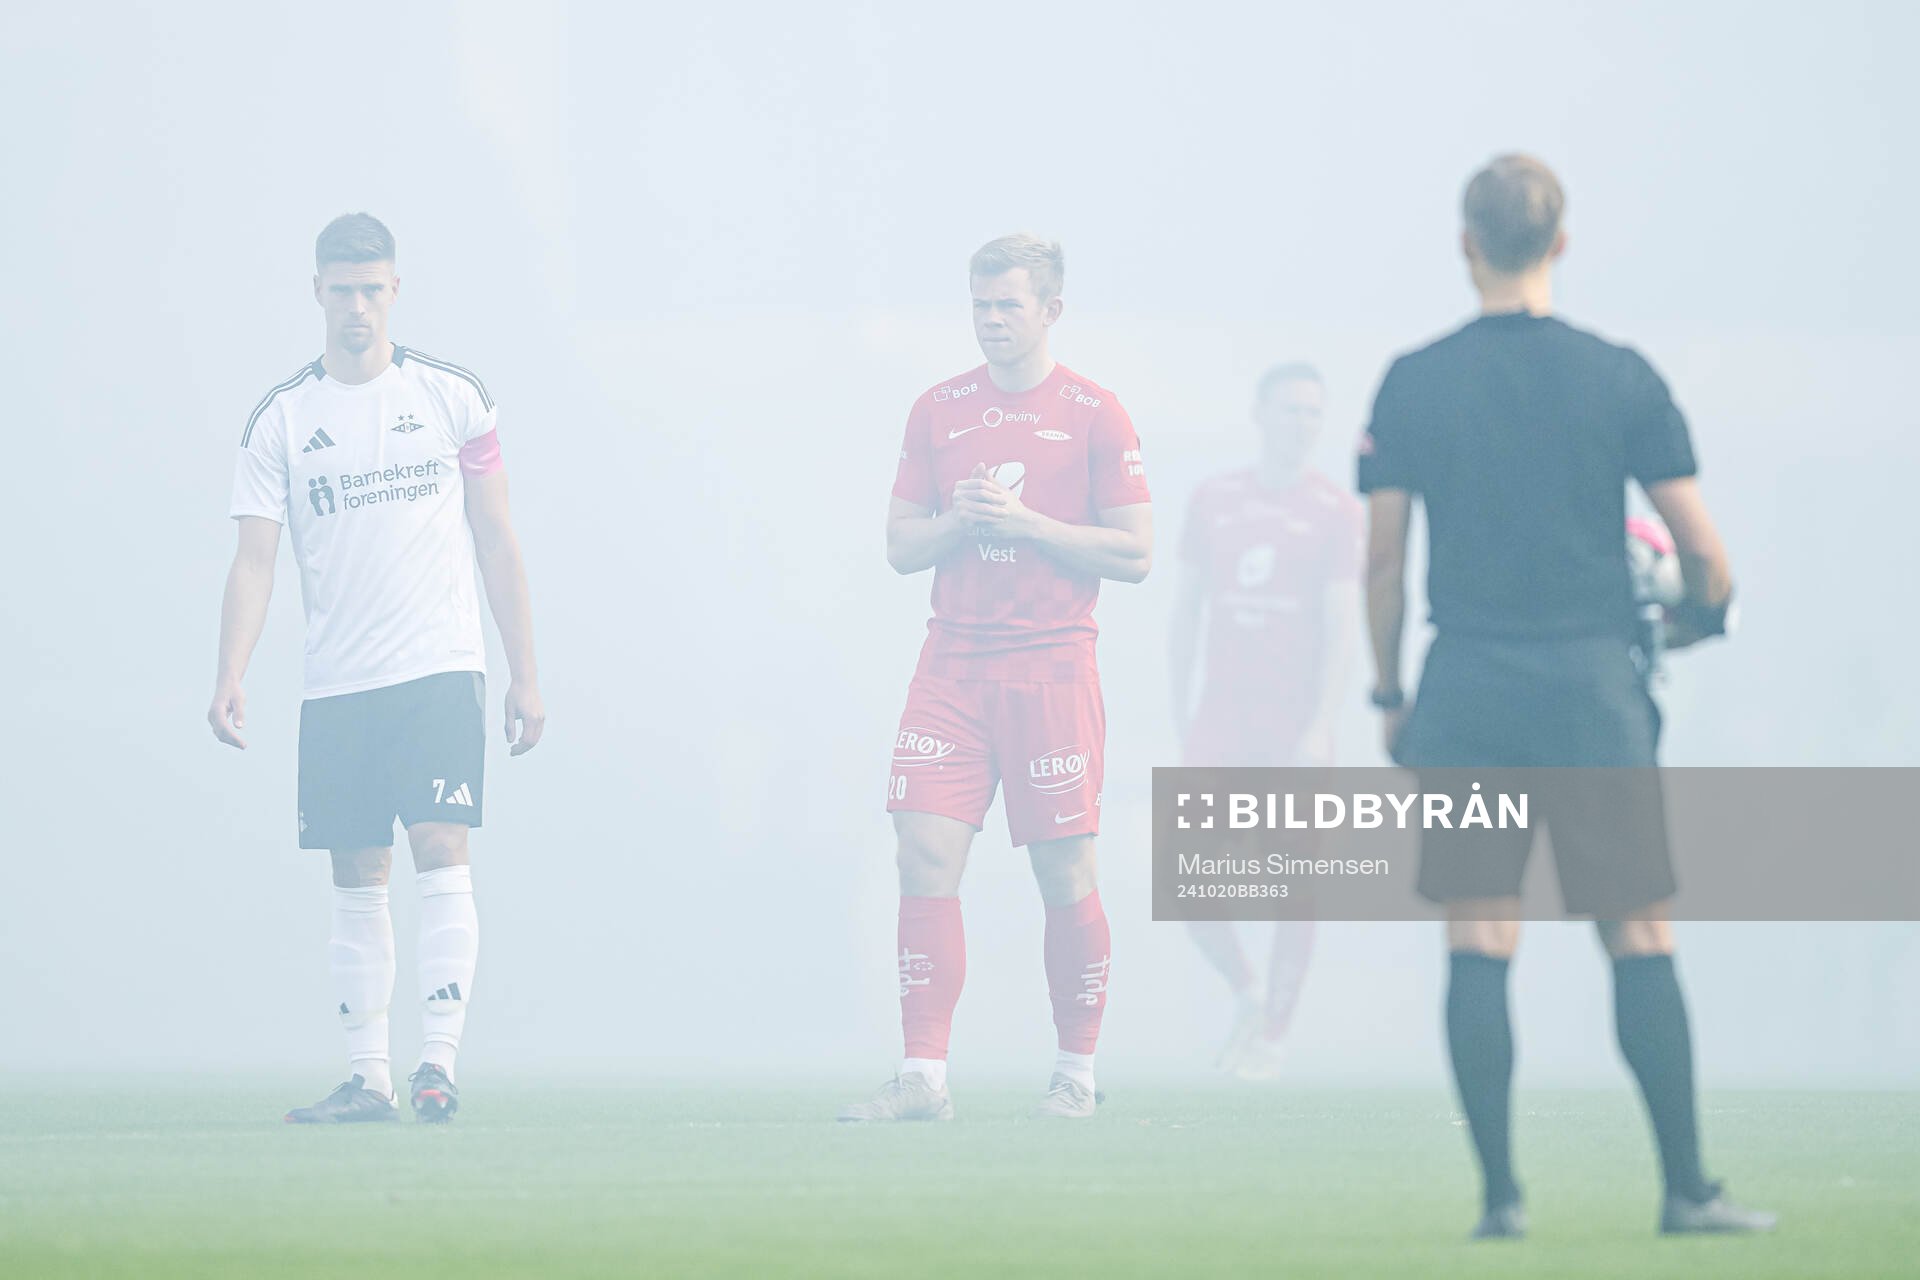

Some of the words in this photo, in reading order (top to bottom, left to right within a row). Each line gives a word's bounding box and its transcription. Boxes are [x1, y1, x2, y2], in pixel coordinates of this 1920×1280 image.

[952, 383, 978, 398] BOB
[1075, 394, 1101, 408] BOB
[1005, 411, 1041, 424] eviny
[340, 460, 439, 491] Barnekreft
[343, 481, 439, 510] foreningen
[978, 543, 1017, 562] Vest
[1030, 751, 1087, 777] LERØY
[432, 779, 446, 803] 7
[889, 775, 907, 800] 20
